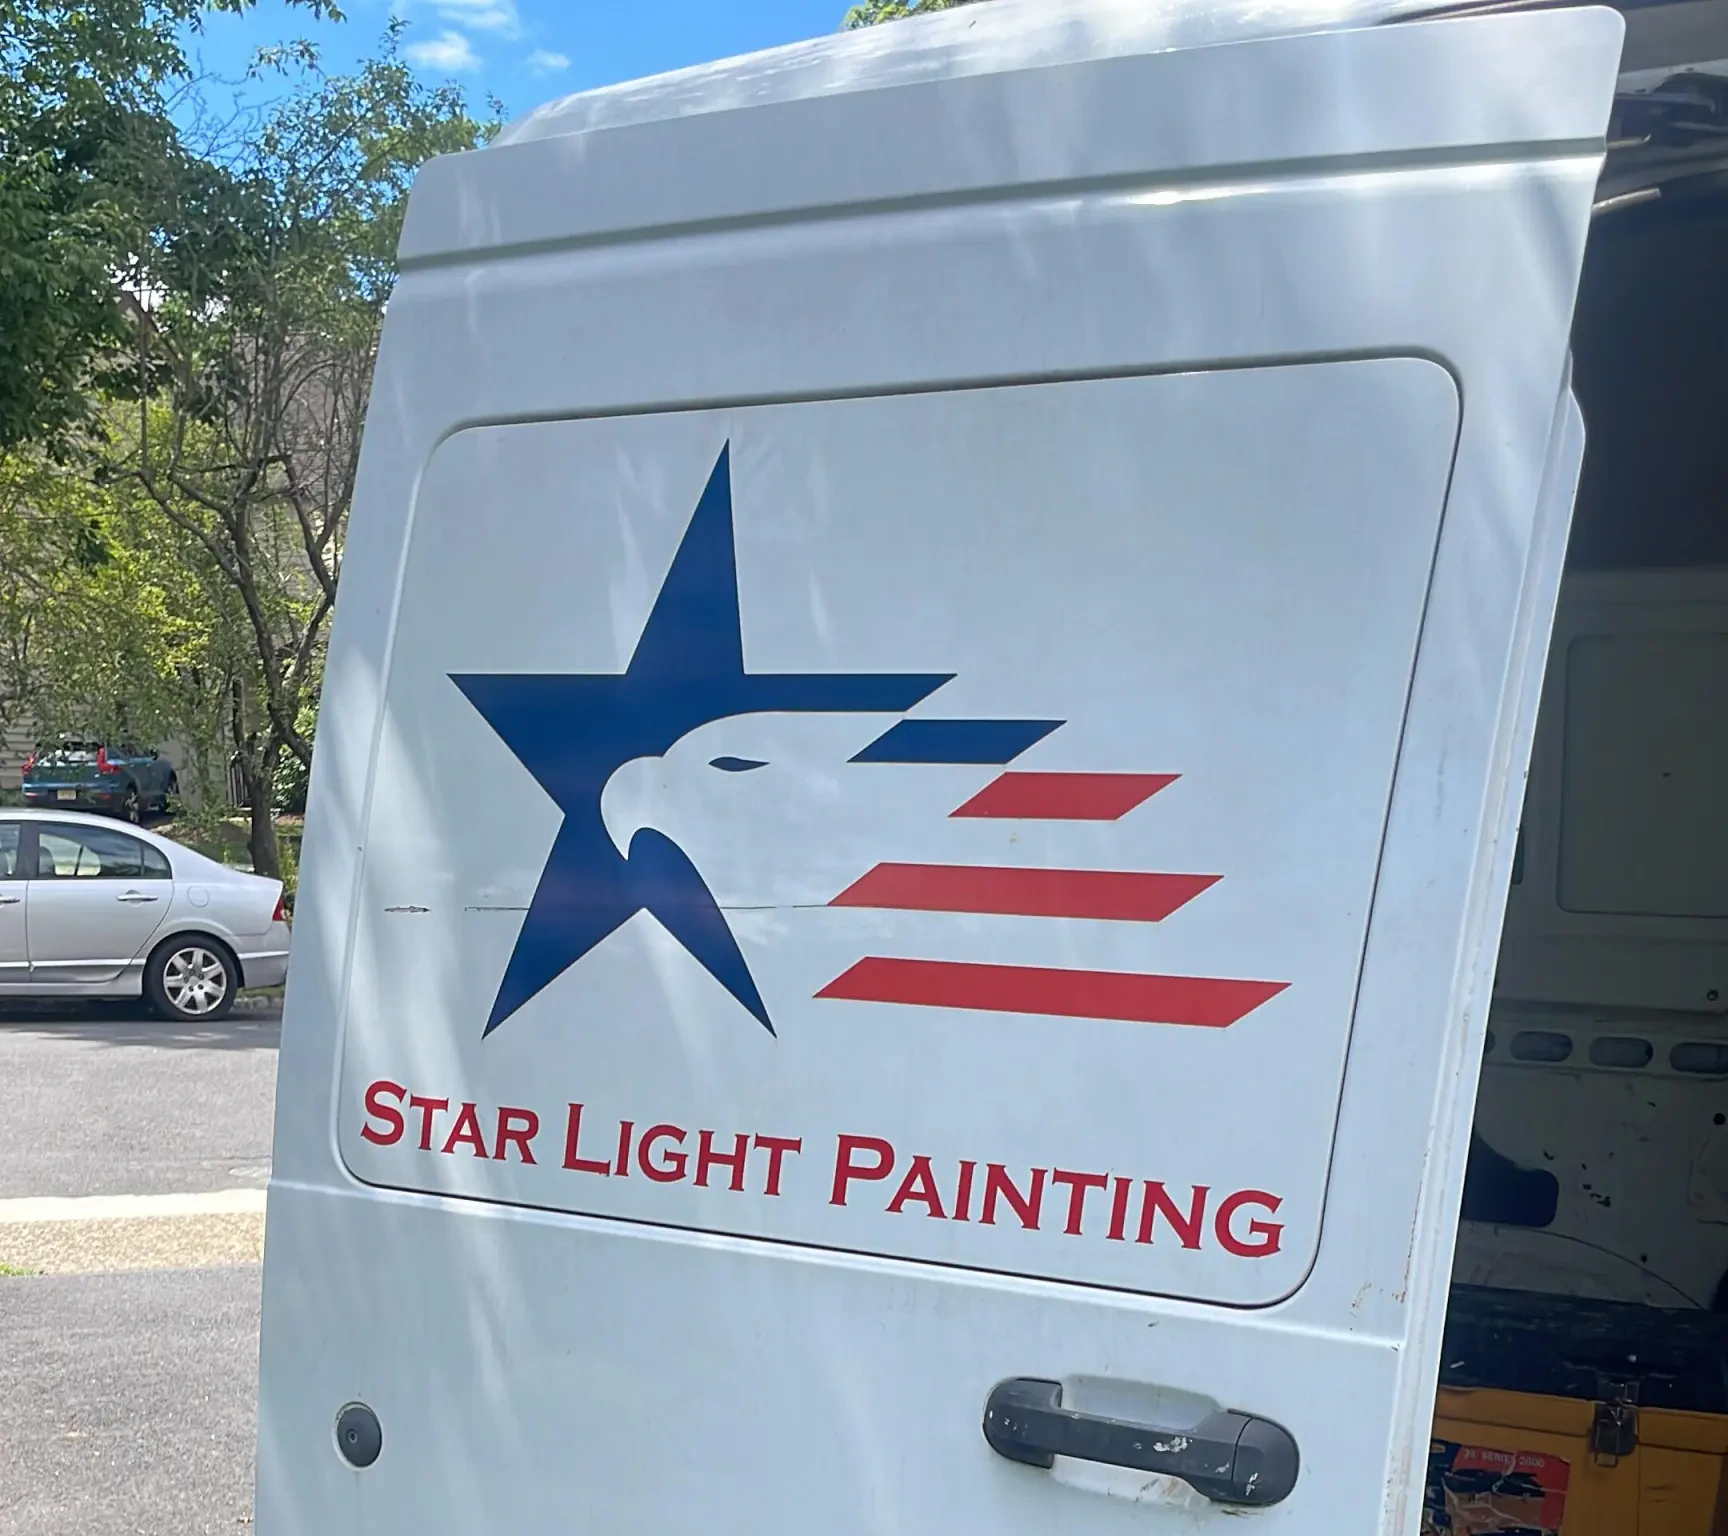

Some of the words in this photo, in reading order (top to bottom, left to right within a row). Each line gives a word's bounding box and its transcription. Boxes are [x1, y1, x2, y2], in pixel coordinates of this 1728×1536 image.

[361, 1080, 539, 1164] STAR
[562, 1102, 802, 1196] LIGHT
[829, 1134, 1284, 1258] PAINTING
